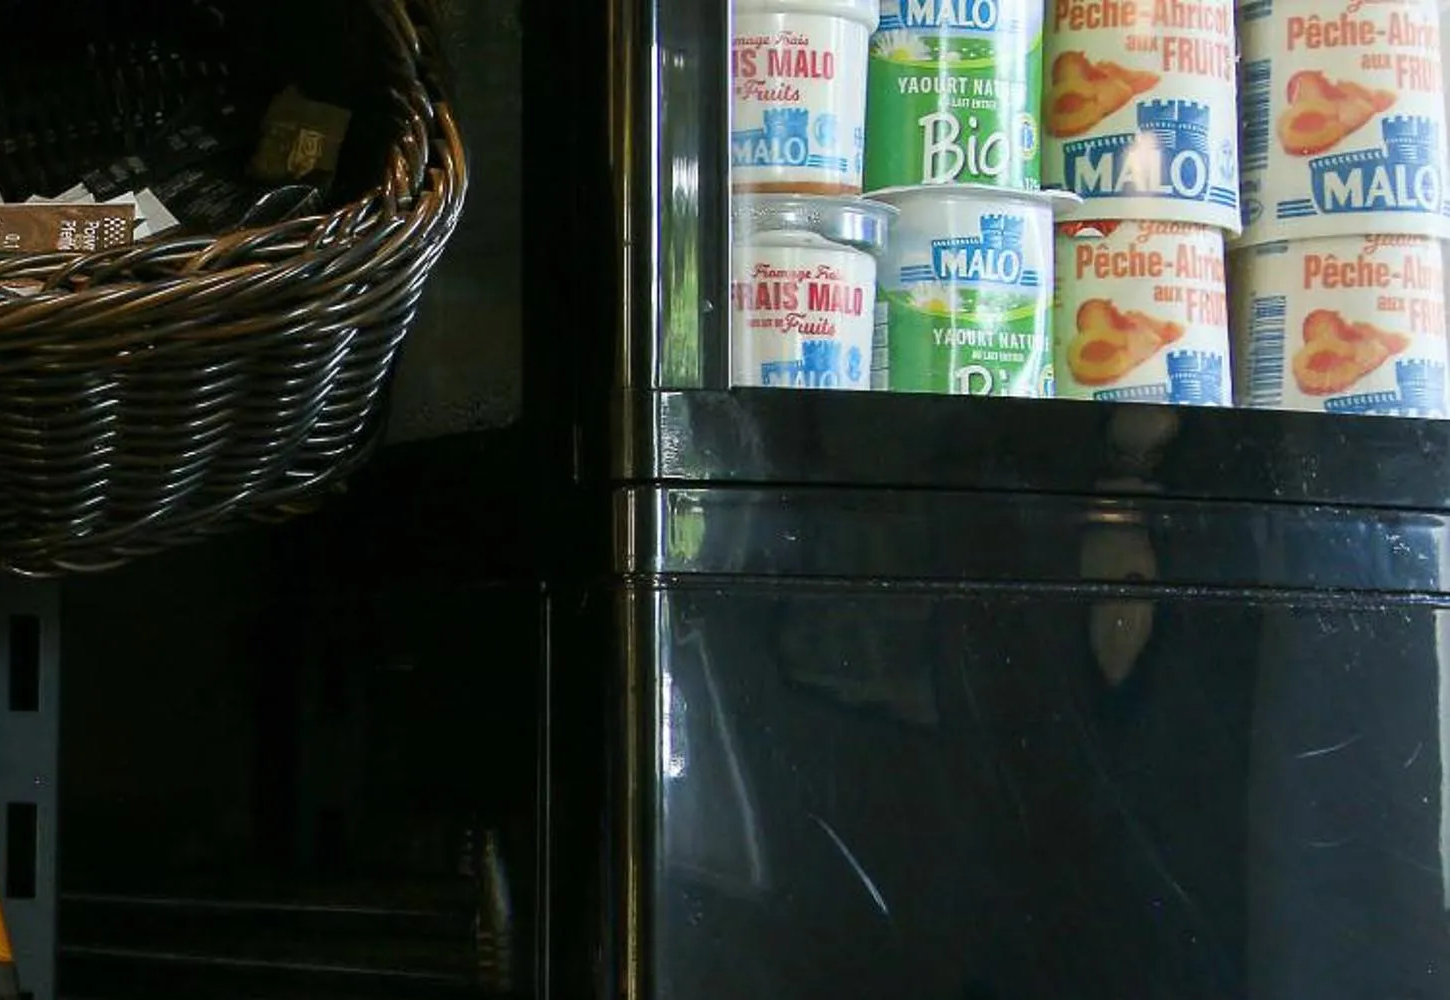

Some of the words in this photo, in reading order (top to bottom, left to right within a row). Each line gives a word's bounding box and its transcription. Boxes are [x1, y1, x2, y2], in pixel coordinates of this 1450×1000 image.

[906, 0, 997, 29] MALO
[1126, 34, 1159, 51] aux
[767, 49, 835, 80] MALO
[1361, 53, 1392, 70] aux
[742, 80, 801, 102] Fruits
[898, 76, 968, 94] YAOURT
[733, 136, 808, 166] MALO
[918, 112, 1011, 185] Bio
[1074, 148, 1208, 198] MALO
[1322, 163, 1444, 211] MALO
[940, 249, 1021, 283] MALO
[807, 281, 864, 317] MALO
[781, 312, 838, 336] Fruits
[933, 327, 994, 347] YAOURT
